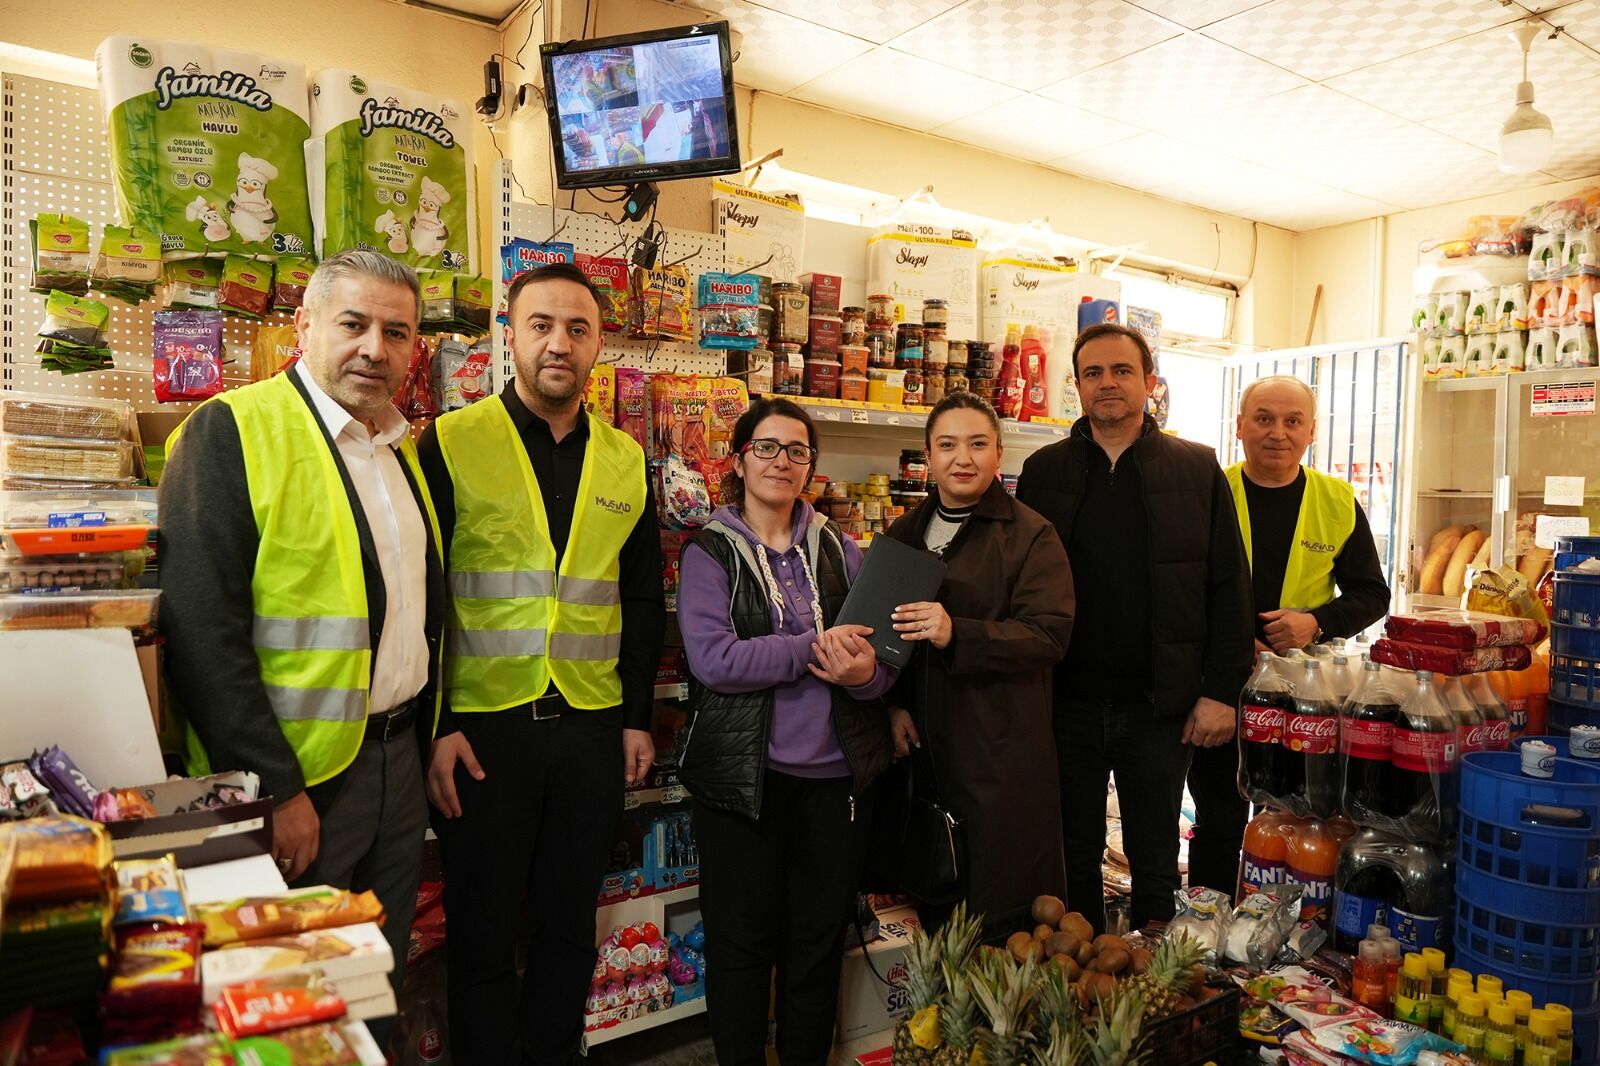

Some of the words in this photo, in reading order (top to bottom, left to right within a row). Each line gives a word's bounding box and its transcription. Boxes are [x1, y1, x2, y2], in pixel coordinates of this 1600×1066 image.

[156, 67, 271, 110] familia
[198, 103, 237, 119] NATURAL
[203, 122, 239, 134] HAVLU
[361, 98, 454, 148] familia
[167, 146, 193, 154] BAMBU
[195, 147, 213, 155] ÖZLÜ
[174, 138, 206, 148] ORGANİK
[398, 152, 427, 166] TOWEL
[736, 188, 758, 199] ULTRA
[758, 195, 789, 207] PACKAGE
[726, 201, 759, 228] Sleepy
[919, 226, 934, 235] 100
[273, 235, 287, 252] 3
[443, 250, 453, 267] 3
[519, 246, 566, 264] HARIBO
[896, 247, 928, 268] Sleepy
[582, 262, 619, 277] HARIBO
[648, 270, 686, 288] HARIBO
[1013, 272, 1039, 291] Sleepy
[710, 282, 753, 295] HARIBO
[685, 404, 706, 416] JOY
[1244, 861, 1285, 884] FANT
